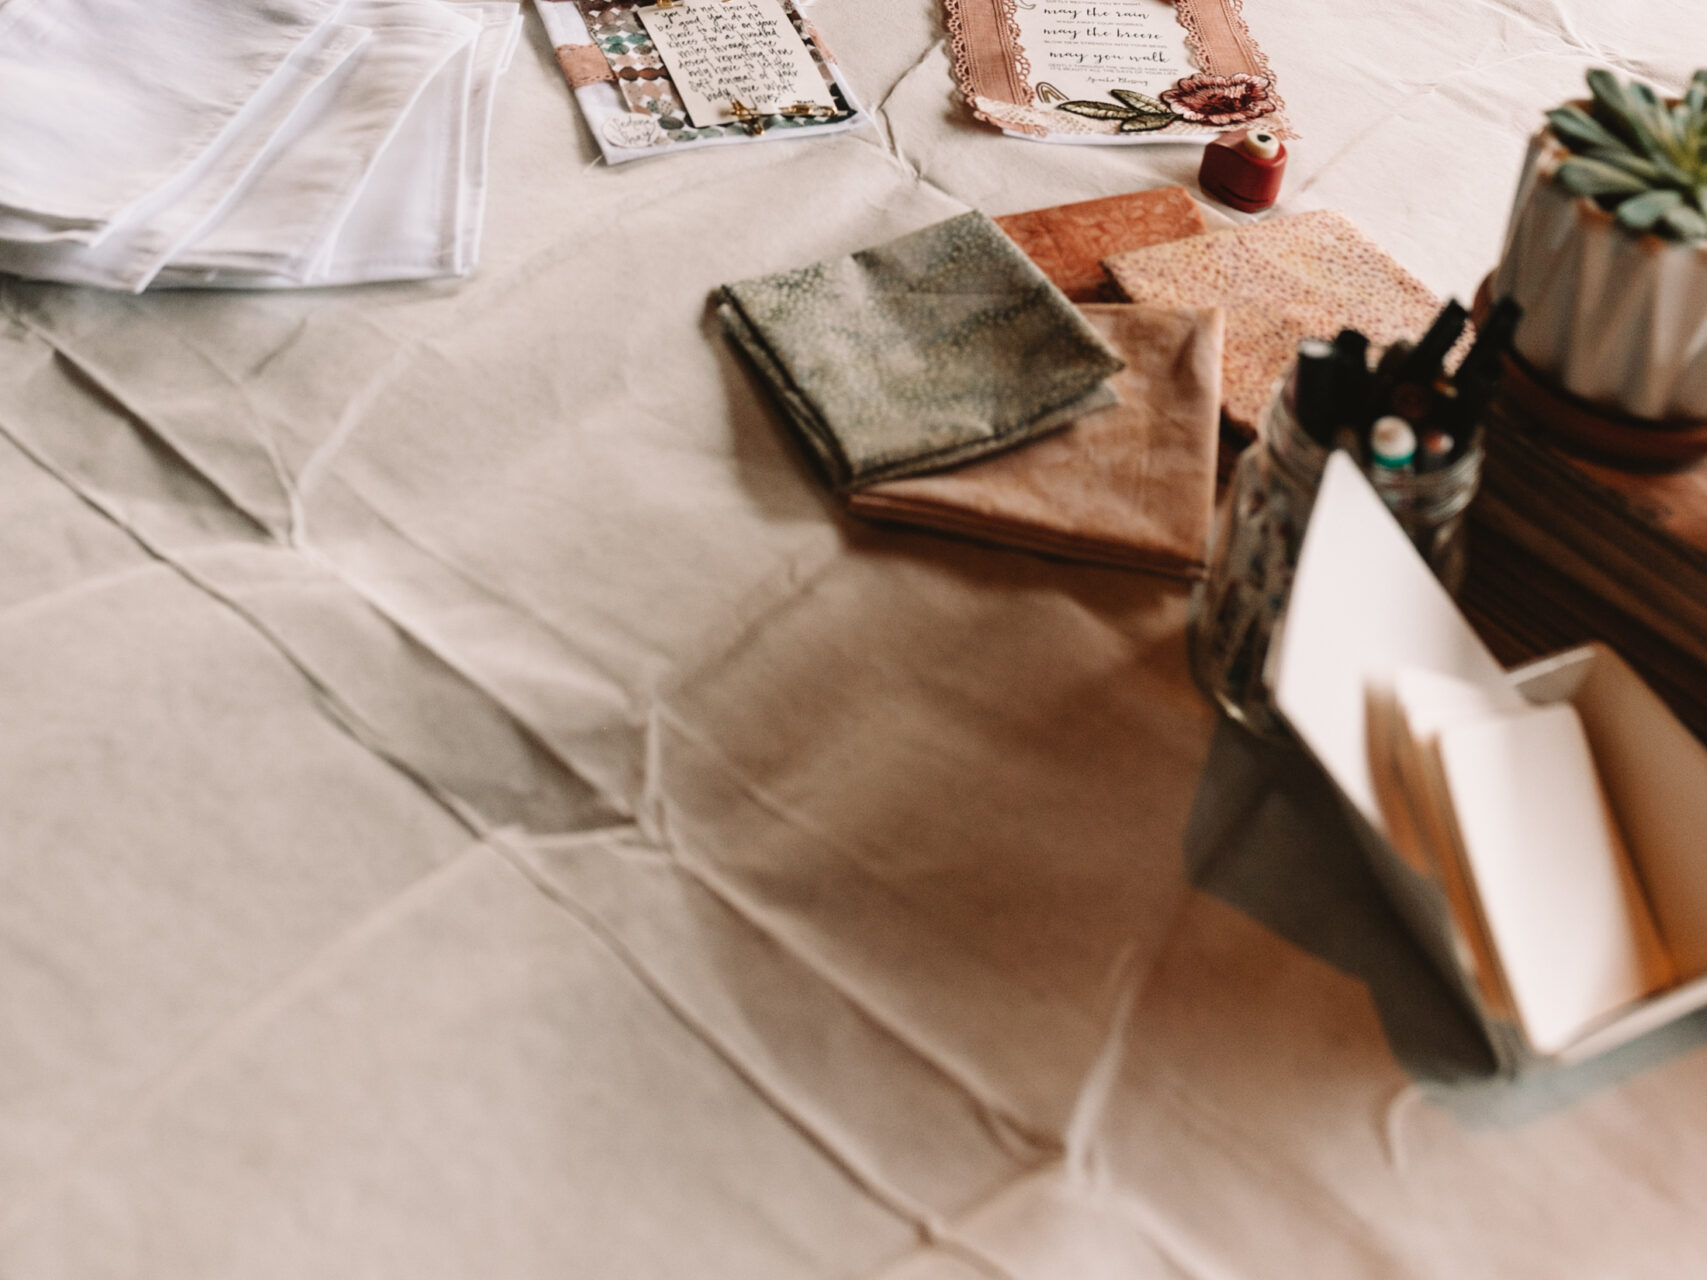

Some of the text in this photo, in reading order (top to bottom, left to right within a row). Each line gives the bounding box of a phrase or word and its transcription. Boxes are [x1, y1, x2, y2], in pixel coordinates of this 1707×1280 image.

[1043, 7, 1150, 20] may the rain
[654, 23, 673, 32] be
[1043, 26, 1162, 40] may the breeze
[666, 30, 694, 41] have
[666, 38, 698, 49] knees
[1049, 51, 1173, 64] may you walk
